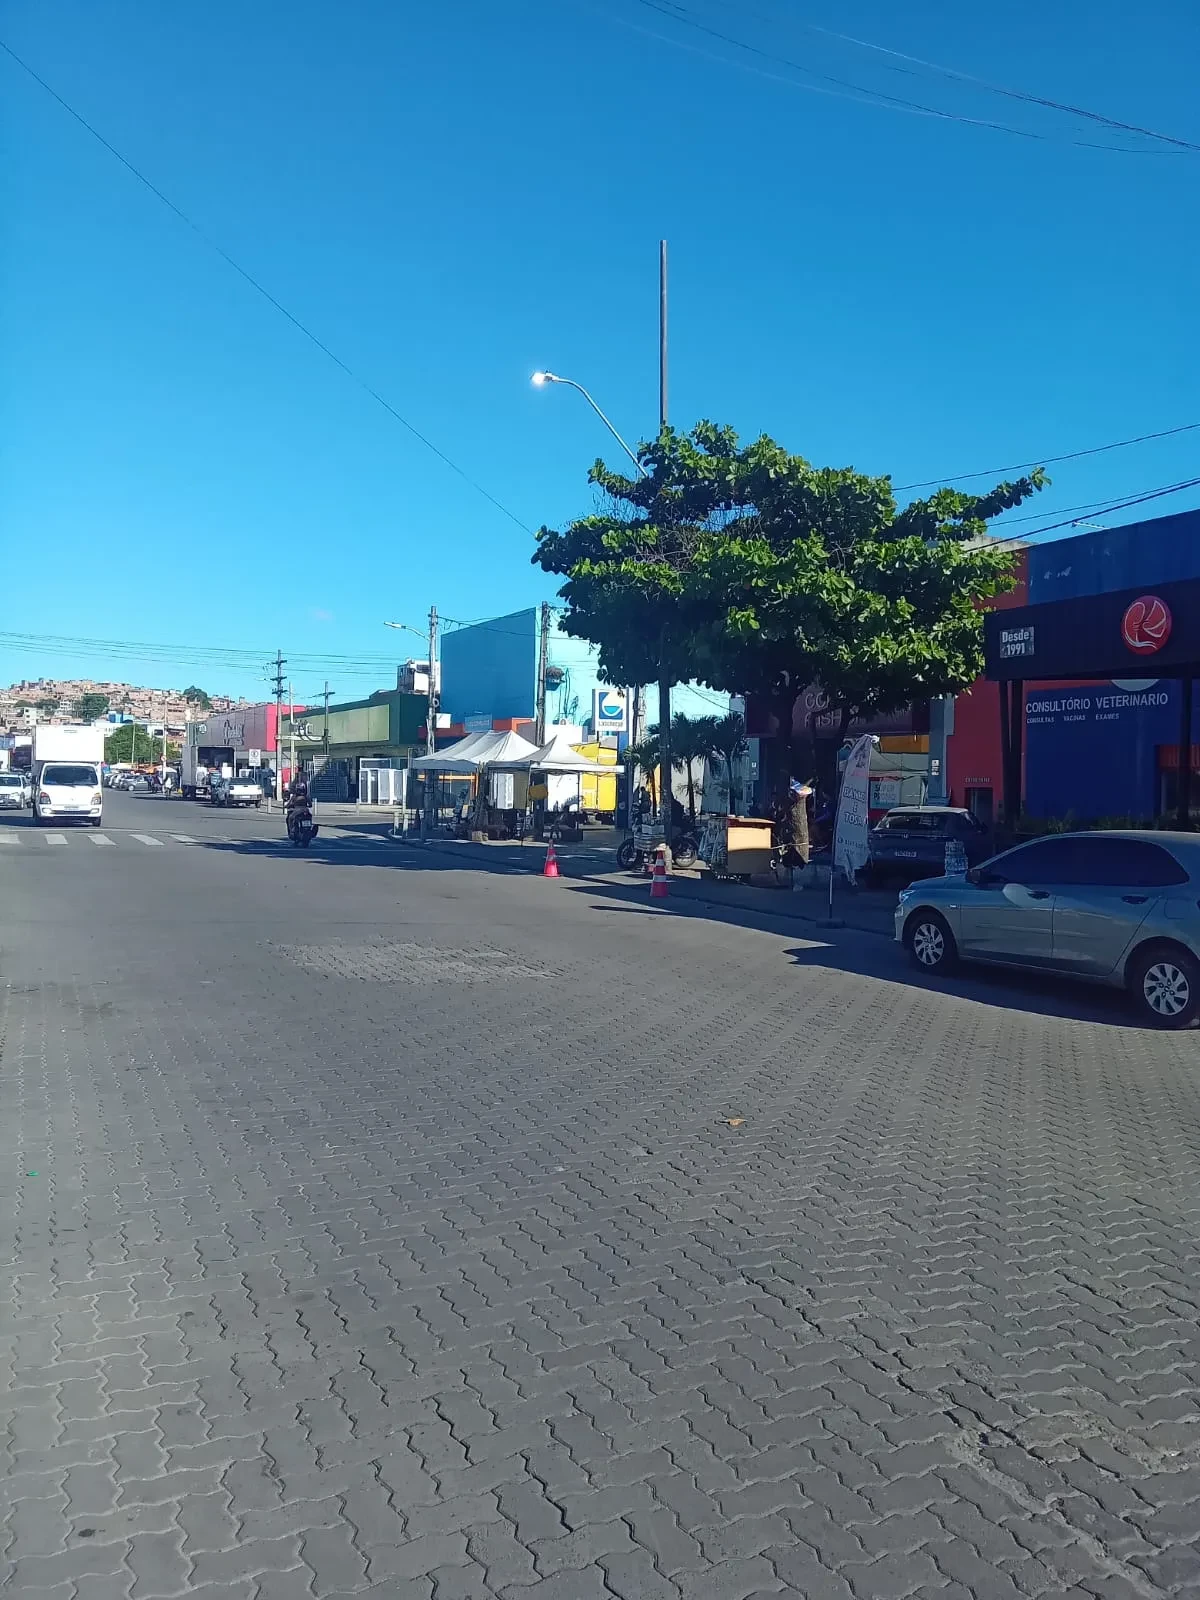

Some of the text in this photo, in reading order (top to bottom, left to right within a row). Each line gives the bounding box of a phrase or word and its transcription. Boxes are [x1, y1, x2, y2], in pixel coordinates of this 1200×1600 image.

[1002, 629, 1029, 643] Desde
[1006, 643, 1025, 656] 1991
[1026, 692, 1168, 713] CONSULTÓRIO VETERINARIO
